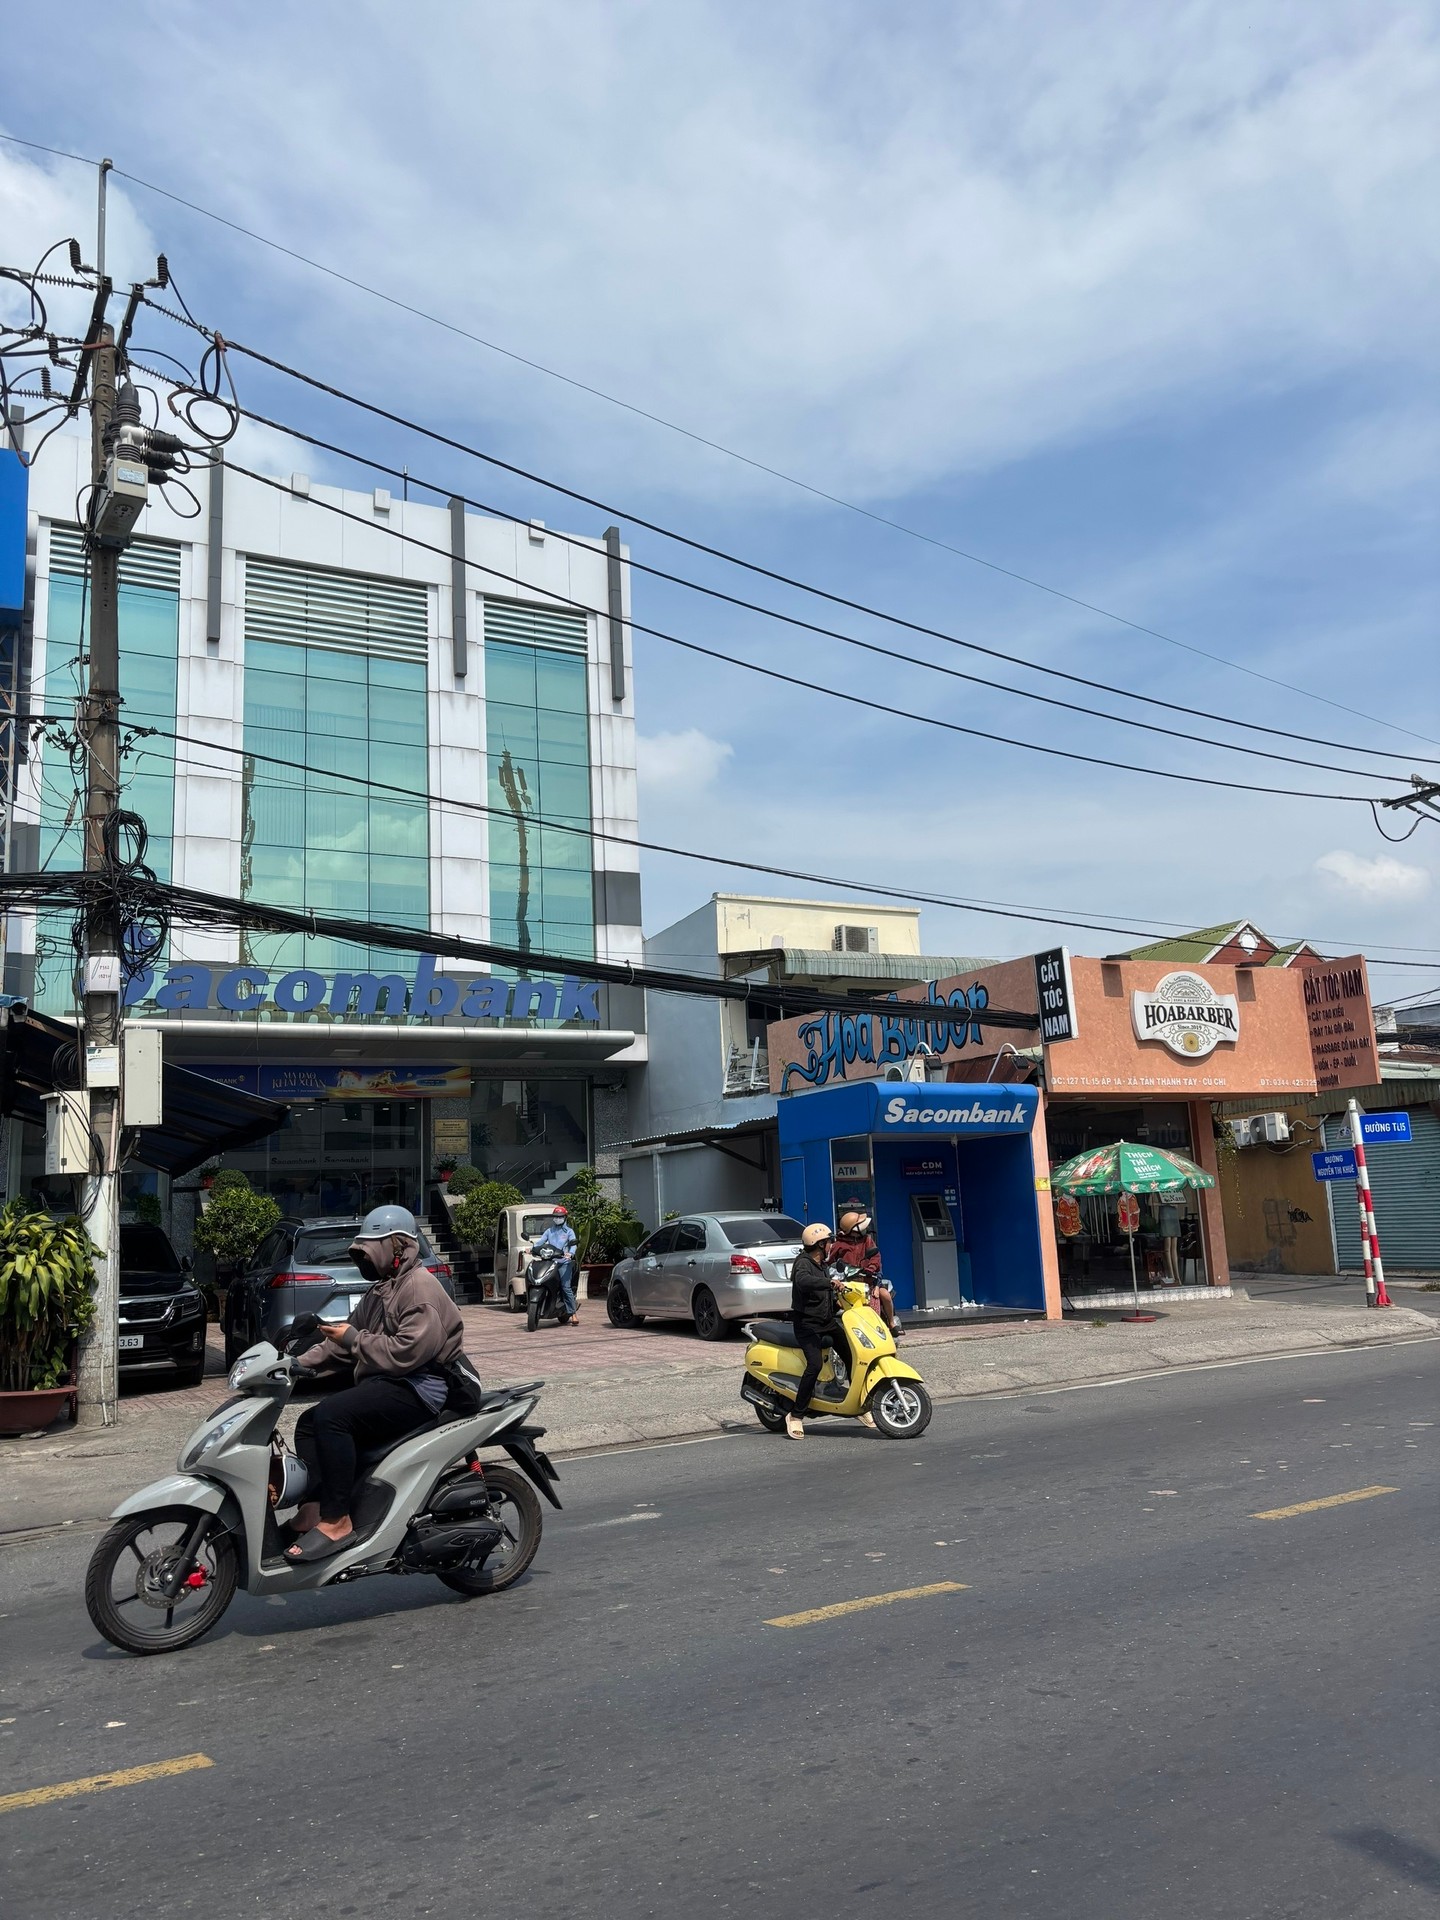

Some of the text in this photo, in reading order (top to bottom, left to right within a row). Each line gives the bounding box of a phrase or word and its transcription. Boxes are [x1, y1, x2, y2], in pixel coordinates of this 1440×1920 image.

[1041, 955, 1060, 984] CẮT
[1043, 985, 1063, 1010] TÓC
[1303, 968, 1365, 1006] CẮT TÓC NAM
[1044, 1014, 1069, 1038] NAM
[1144, 1004, 1237, 1032] HOABARBER
[1316, 1042, 1341, 1054] MASSAGE
[1214, 1078, 1226, 1086] CHI
[884, 1098, 1028, 1123] Sacombank
[1365, 1121, 1390, 1133] ĐƯỜNG
[1325, 1154, 1343, 1164] ĐƯỜNG
[838, 1167, 857, 1175] ATM
[439, 1416, 478, 1434] VISION
